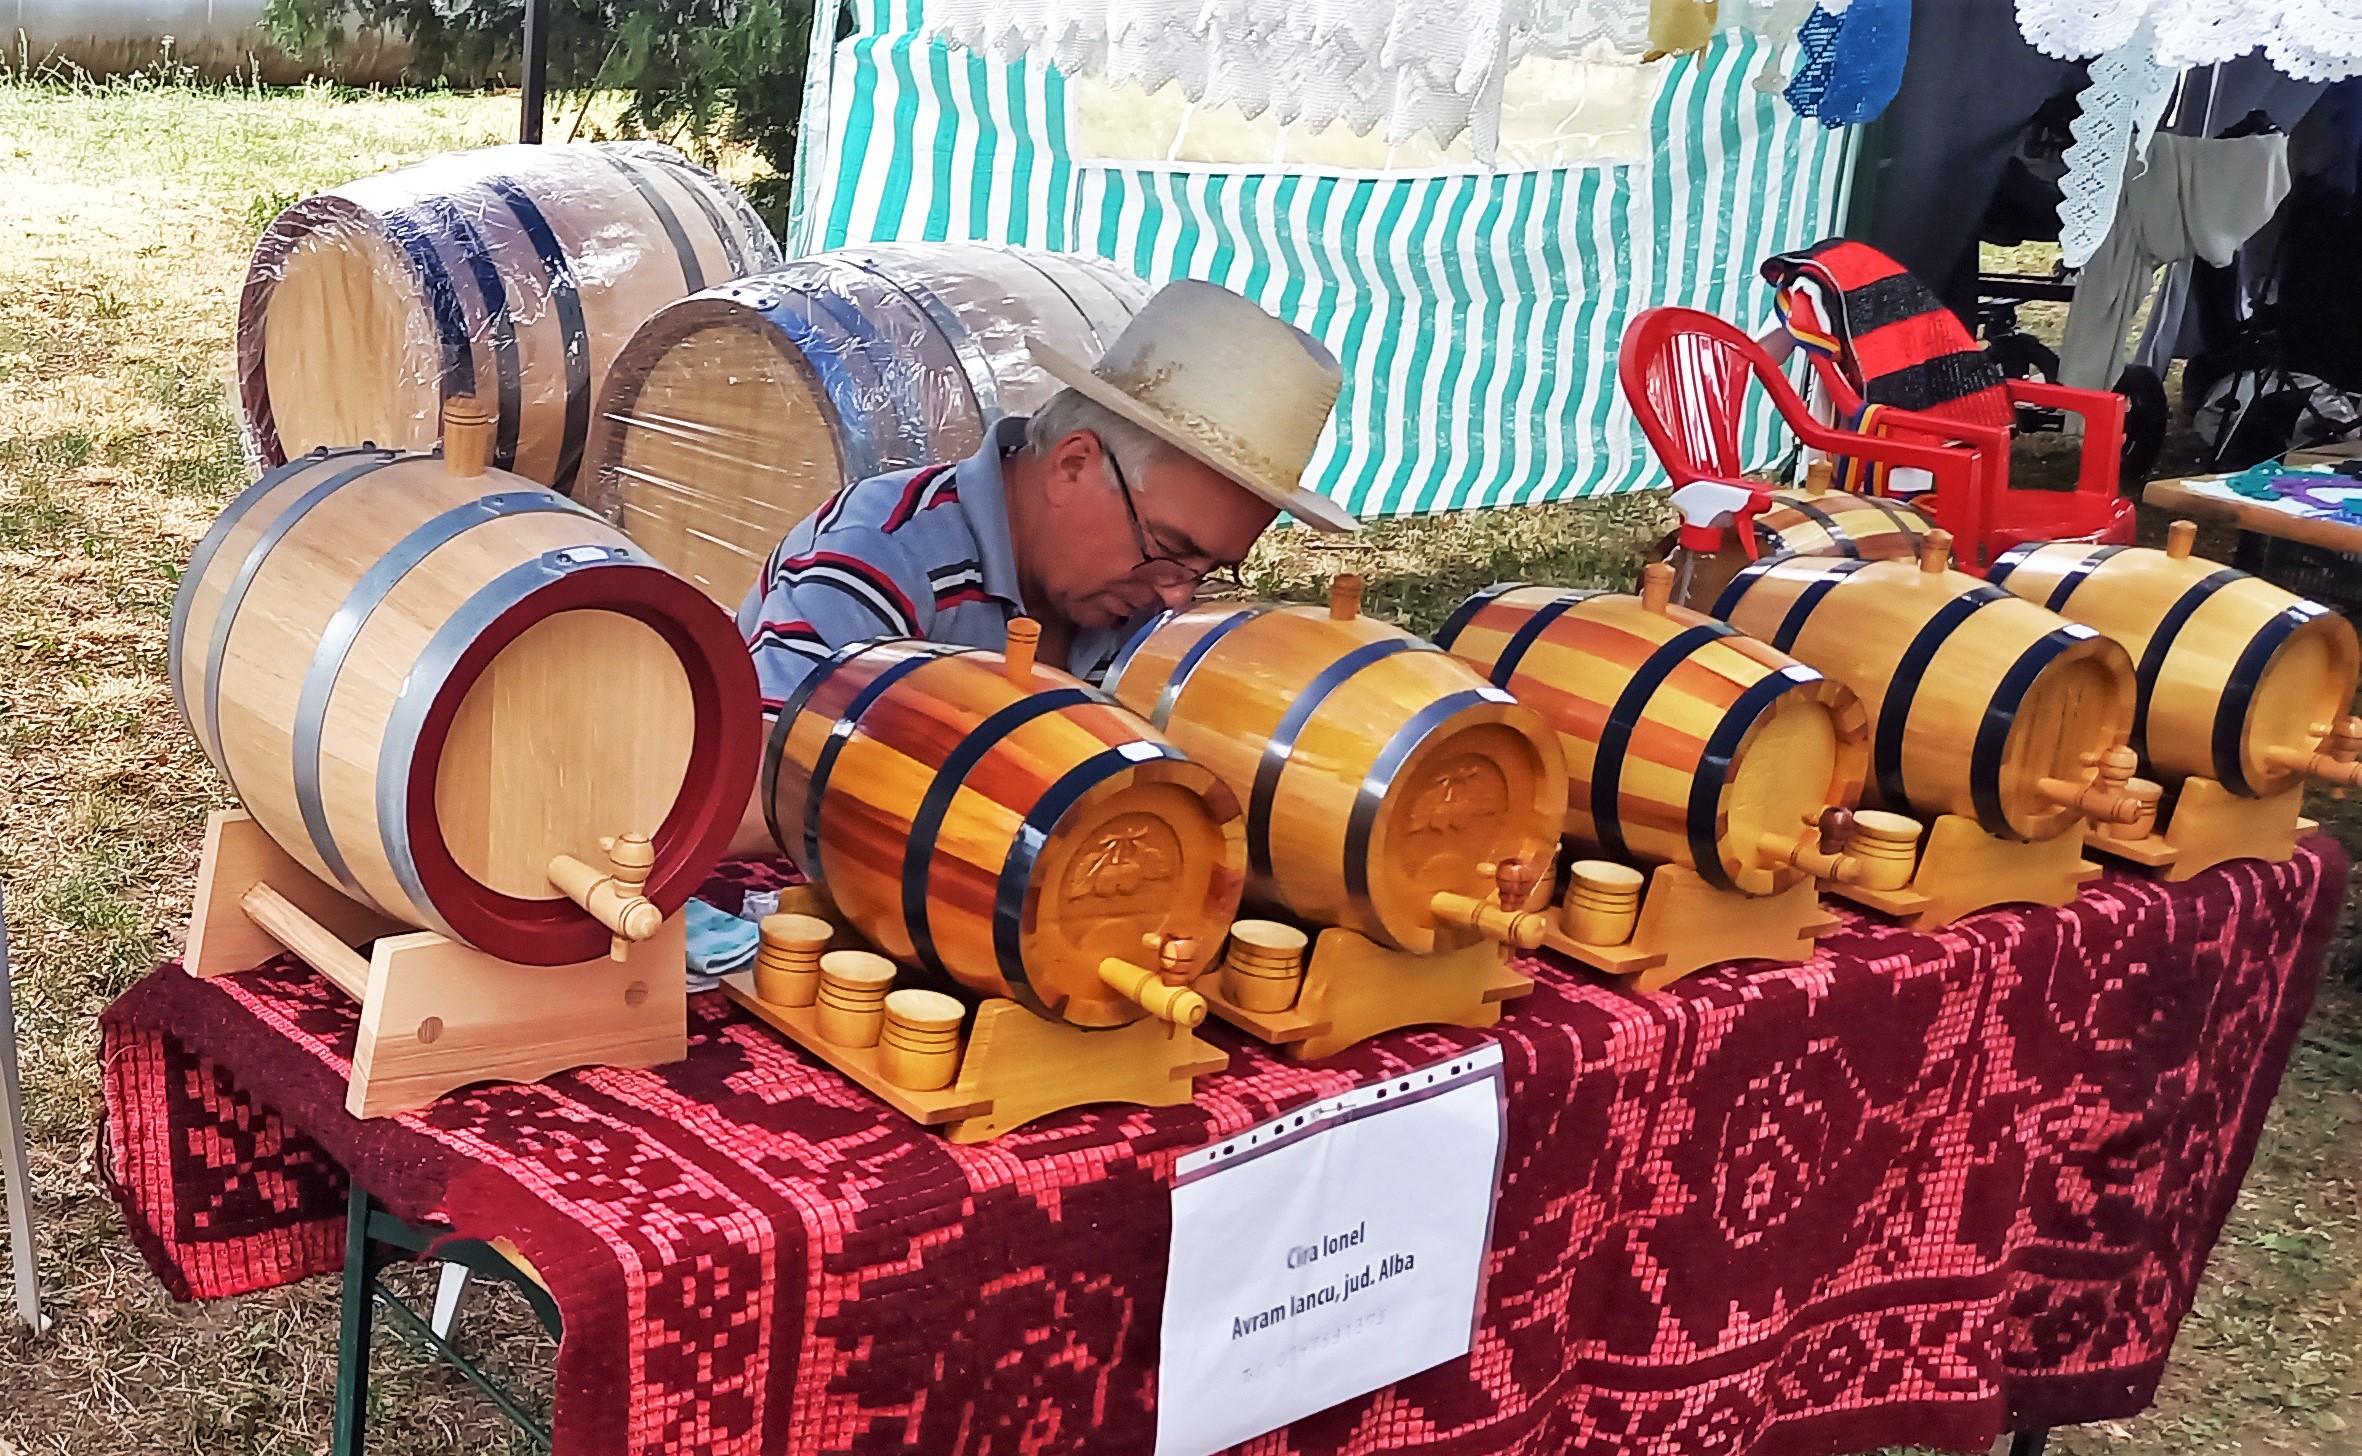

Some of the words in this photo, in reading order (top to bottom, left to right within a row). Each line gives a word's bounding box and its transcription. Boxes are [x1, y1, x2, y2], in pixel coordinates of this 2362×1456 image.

[1323, 1221, 1365, 1257] Ionel
[1232, 1304, 1286, 1340] Avram
[1290, 1285, 1341, 1317] Iancu,
[1342, 1265, 1375, 1302] jud.
[1379, 1253, 1415, 1282] Alba
